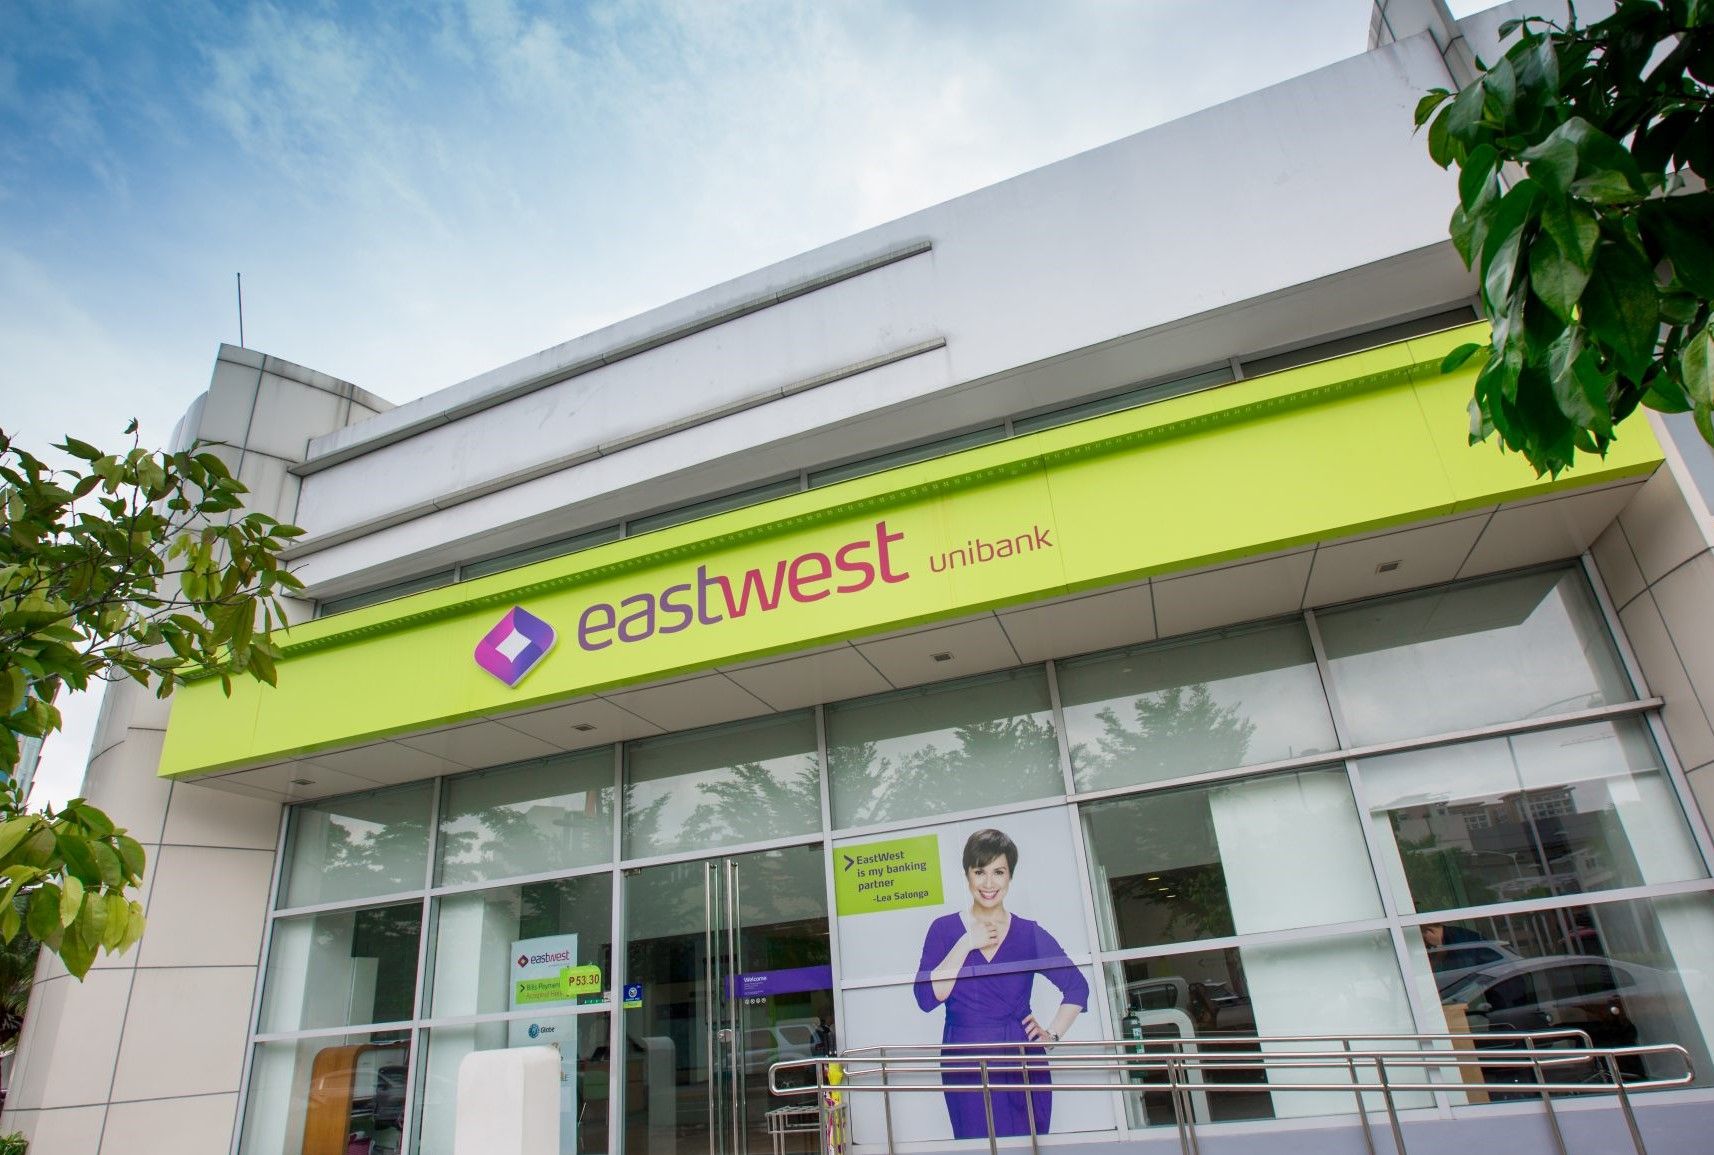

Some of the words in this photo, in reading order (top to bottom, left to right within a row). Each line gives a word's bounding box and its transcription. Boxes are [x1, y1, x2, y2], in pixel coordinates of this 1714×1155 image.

[578, 521, 910, 652] eastwest
[930, 525, 1053, 572] unibank
[856, 851, 905, 865] EastWest
[857, 869, 866, 878] is
[868, 867, 884, 877] my
[886, 861, 927, 874] banking
[858, 879, 895, 892] partner
[873, 894, 892, 903] -Lea
[894, 890, 929, 900] Salonga
[530, 950, 570, 965] eastwest
[540, 1025, 556, 1034] Globe
